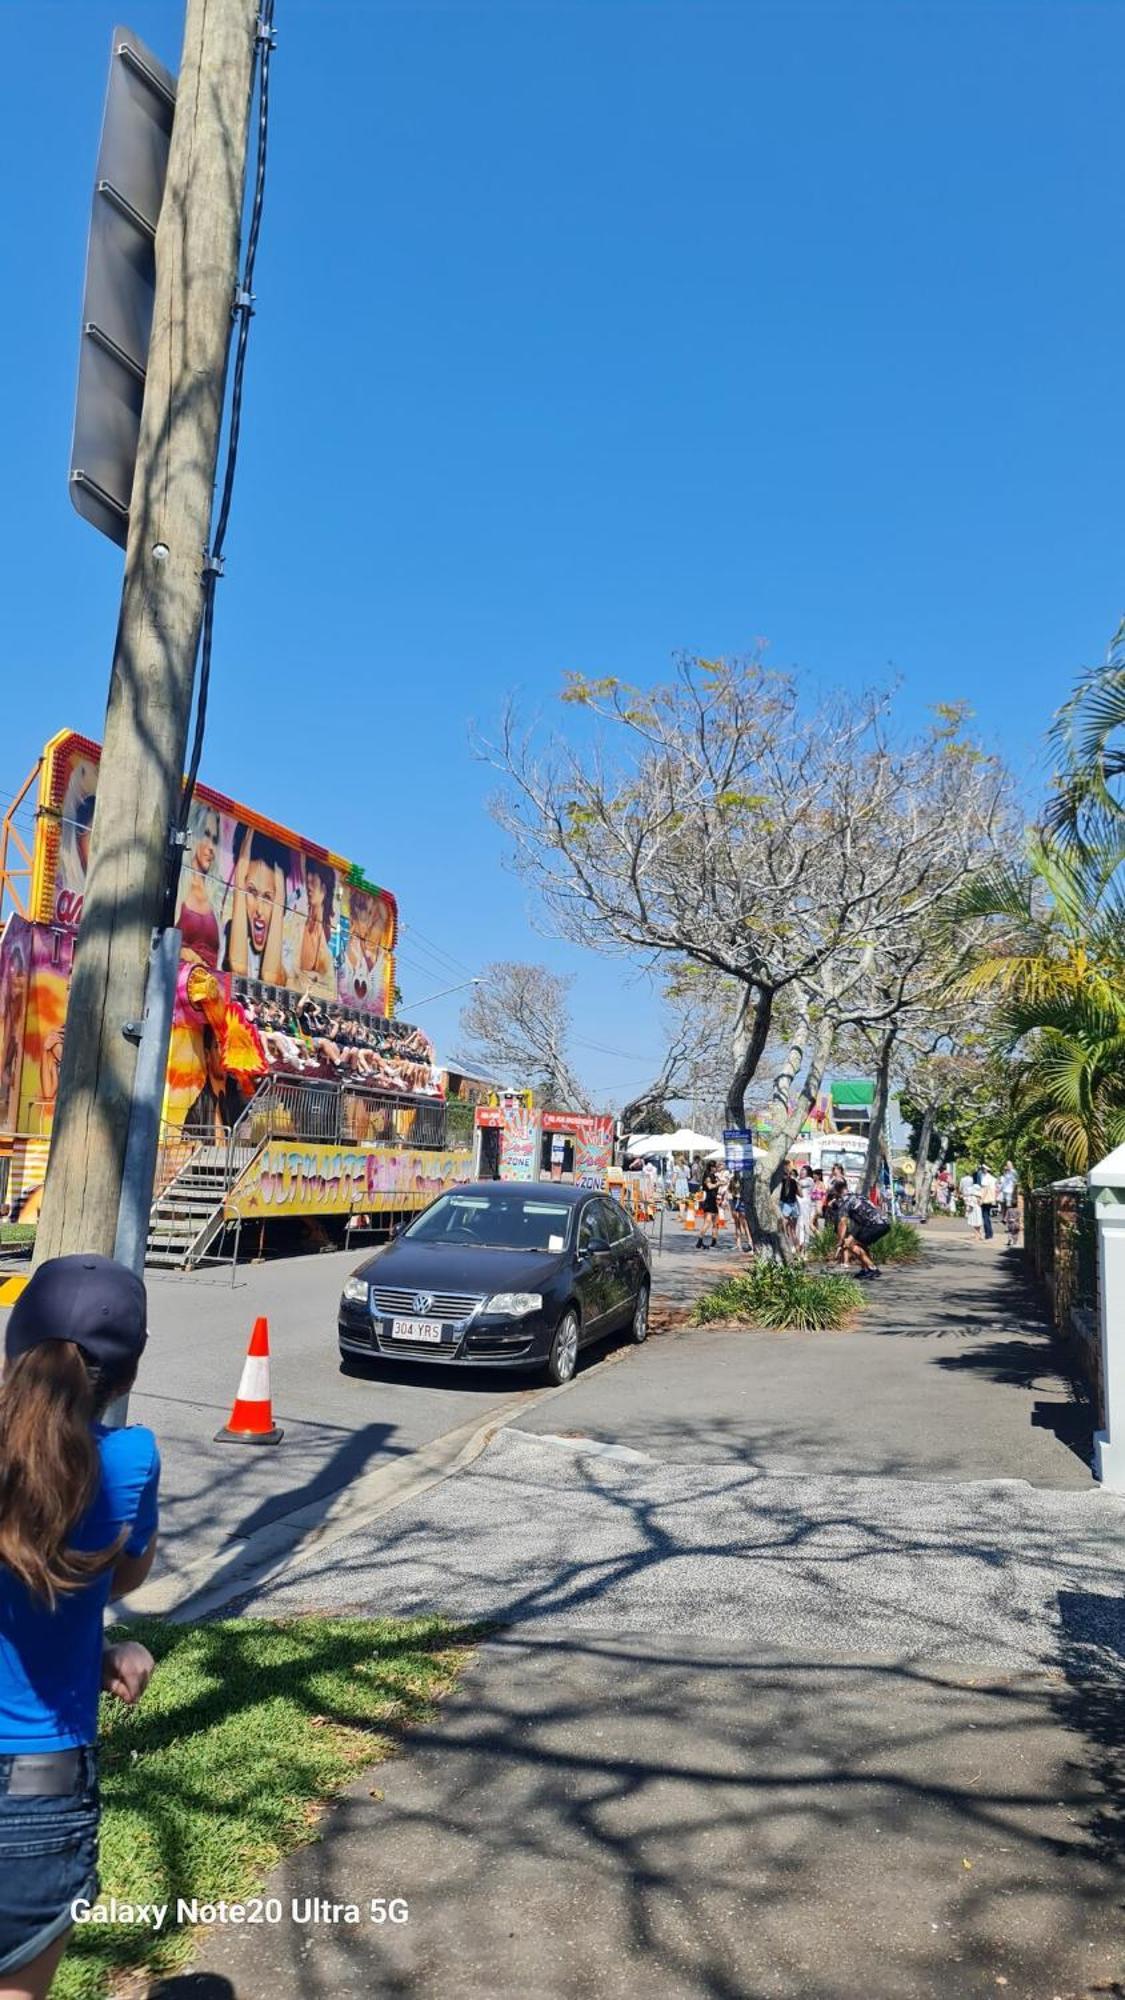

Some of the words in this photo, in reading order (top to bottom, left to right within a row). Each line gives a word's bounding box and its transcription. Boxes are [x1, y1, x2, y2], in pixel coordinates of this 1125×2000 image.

[507, 1156, 530, 1167] ZONE
[580, 1176, 605, 1190] ZONE
[394, 1321, 413, 1336] 304
[416, 1324, 440, 1338] YRS
